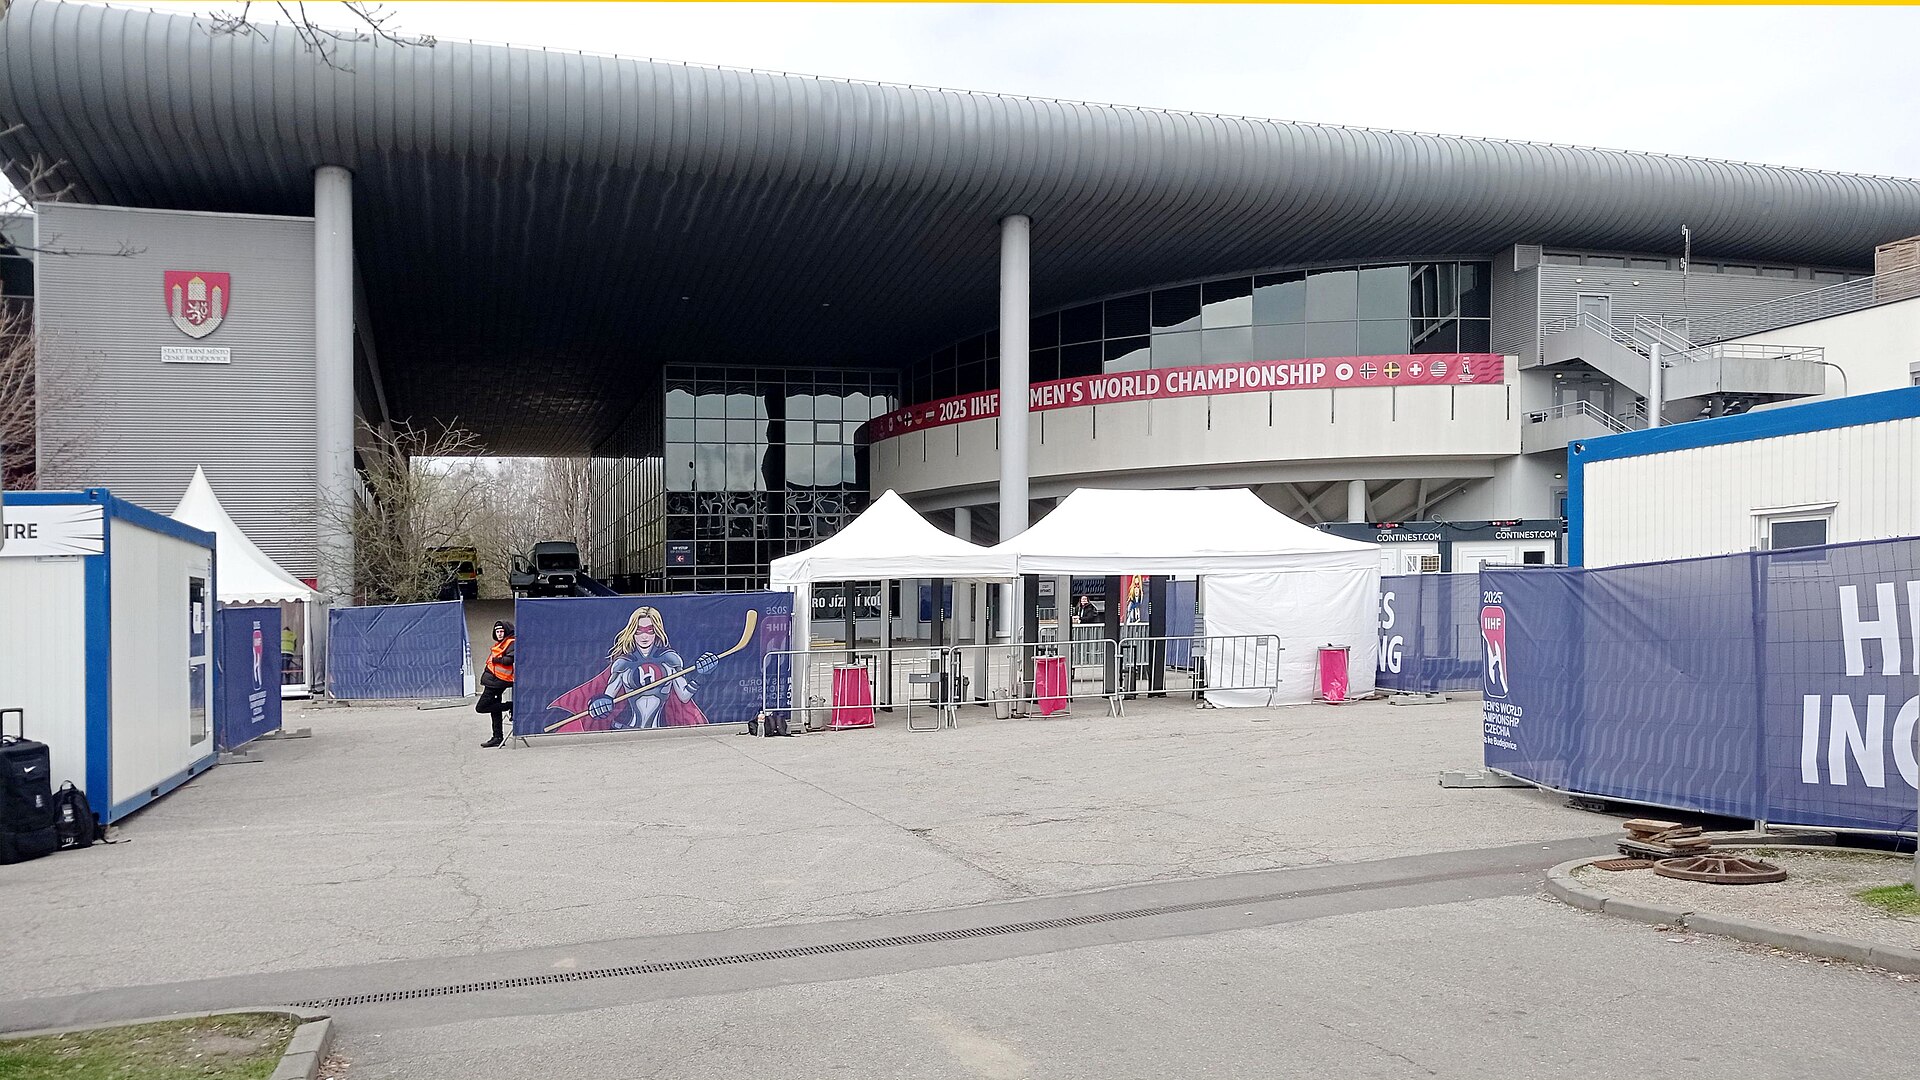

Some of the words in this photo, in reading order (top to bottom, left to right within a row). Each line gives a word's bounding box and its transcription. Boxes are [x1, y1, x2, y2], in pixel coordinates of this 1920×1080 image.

[939, 402, 967, 422] 2025
[970, 393, 998, 417] IIHF
[1030, 382, 1084, 408] MEN'S
[1089, 374, 1160, 401] WORLD
[1166, 362, 1327, 393] CHAMPIONSHIP
[3, 523, 38, 539] TRE
[1376, 533, 1441, 542] CONTINEST.COM
[1495, 530, 1557, 539] CONTINEST.COM
[1483, 591, 1503, 604] 2025
[1485, 617, 1501, 630] IIHF
[1500, 702, 1523, 717] WORLD
[1484, 723, 1511, 738] CZECHIA
